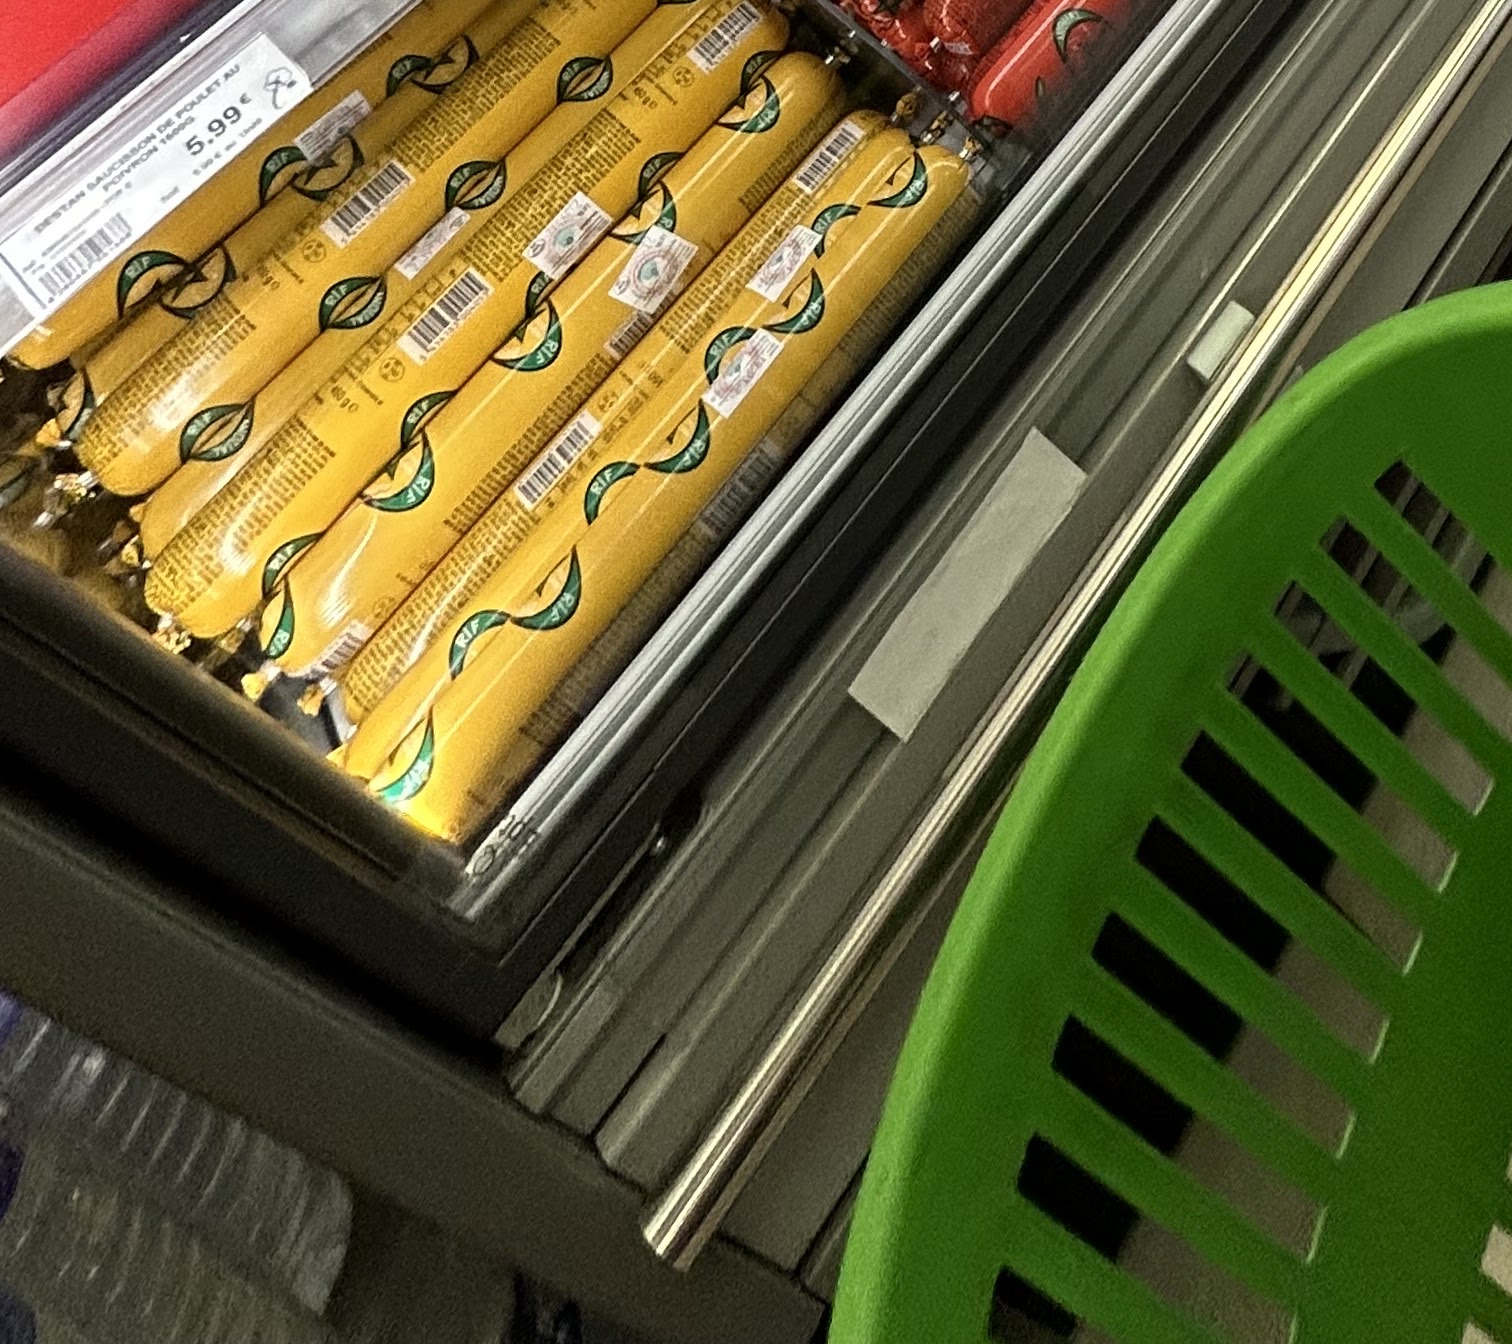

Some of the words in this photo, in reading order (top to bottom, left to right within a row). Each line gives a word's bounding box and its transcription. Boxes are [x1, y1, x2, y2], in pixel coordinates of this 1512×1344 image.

[33, 189, 86, 234] DESTAN
[155, 118, 176, 136] DE
[174, 79, 223, 120] POULET
[221, 63, 242, 83] AU
[324, 283, 348, 306] RIF
[406, 400, 431, 425] RIF
[405, 476, 432, 504] RIF
[589, 469, 615, 496] RIF
[454, 619, 481, 649] RIF
